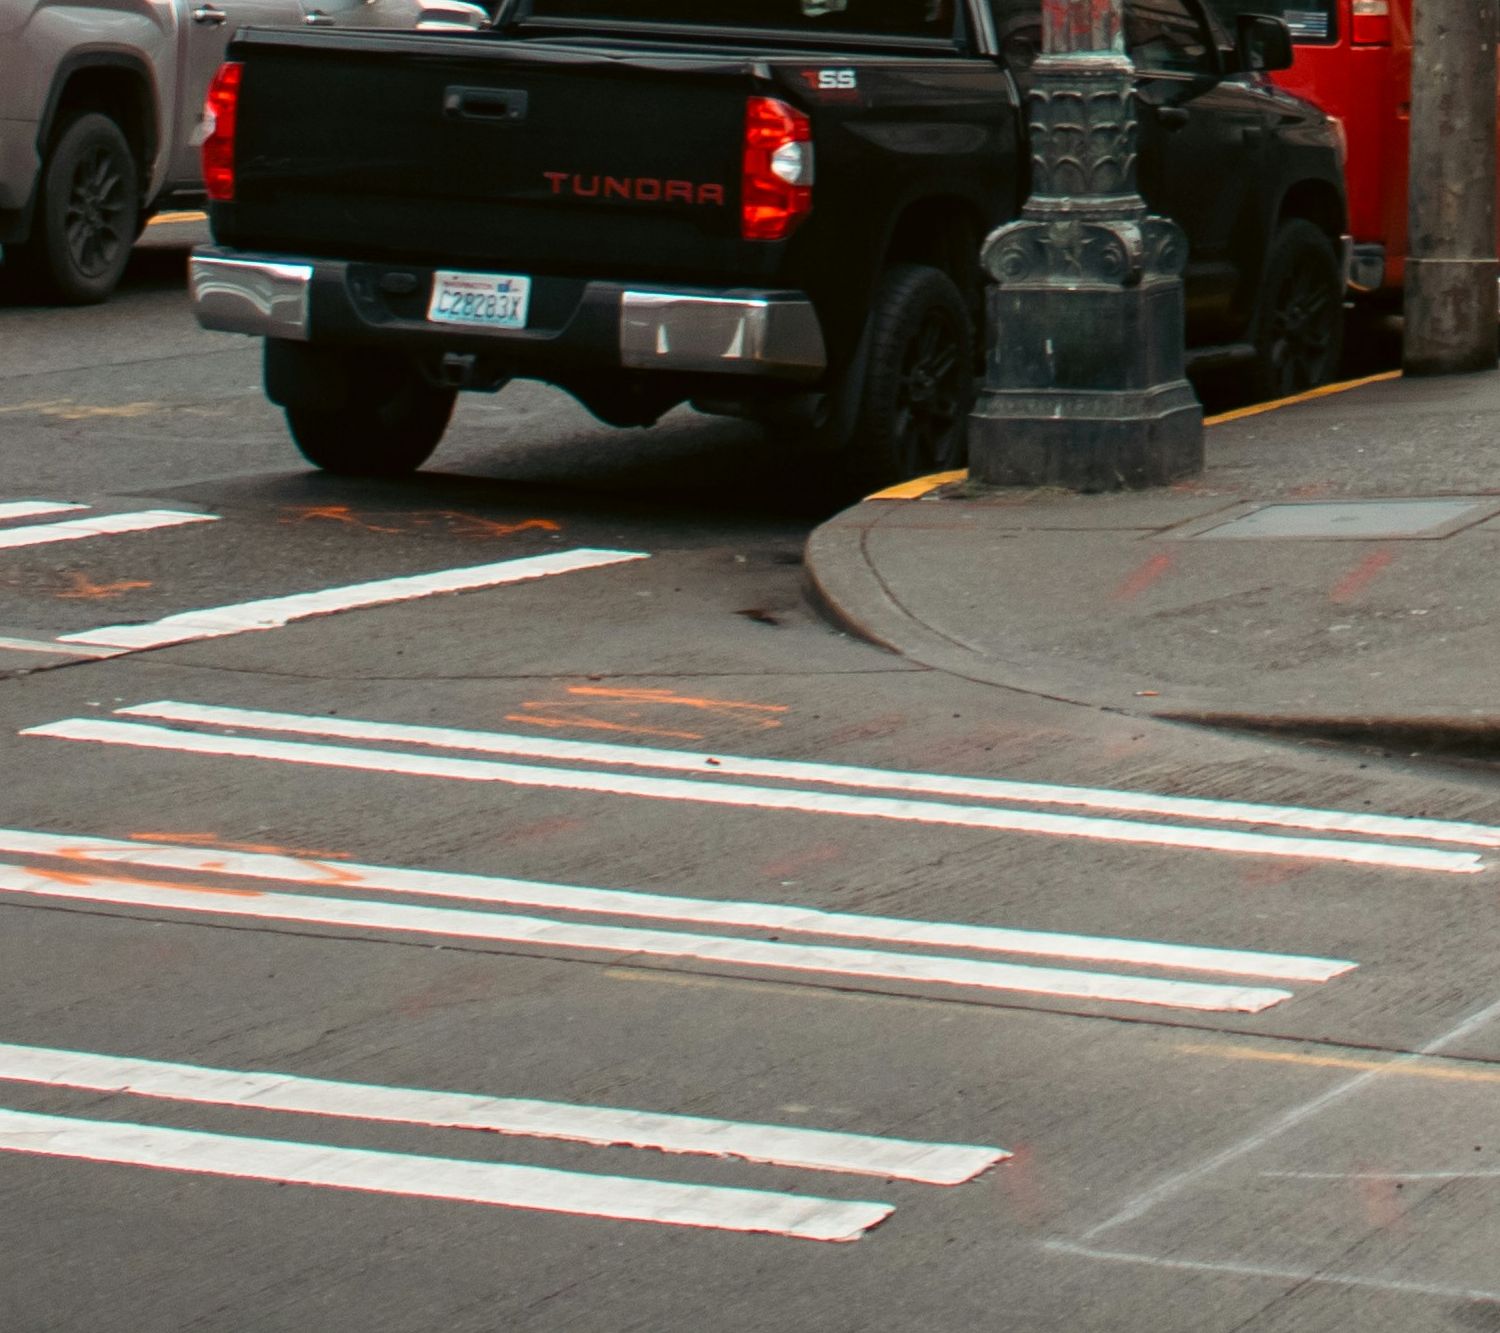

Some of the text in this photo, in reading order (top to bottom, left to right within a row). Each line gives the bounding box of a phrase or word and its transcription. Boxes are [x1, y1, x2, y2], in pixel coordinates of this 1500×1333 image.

[800, 69, 857, 89] TSS
[543, 171, 725, 206] TUNDRA
[437, 289, 523, 321] C28283X
